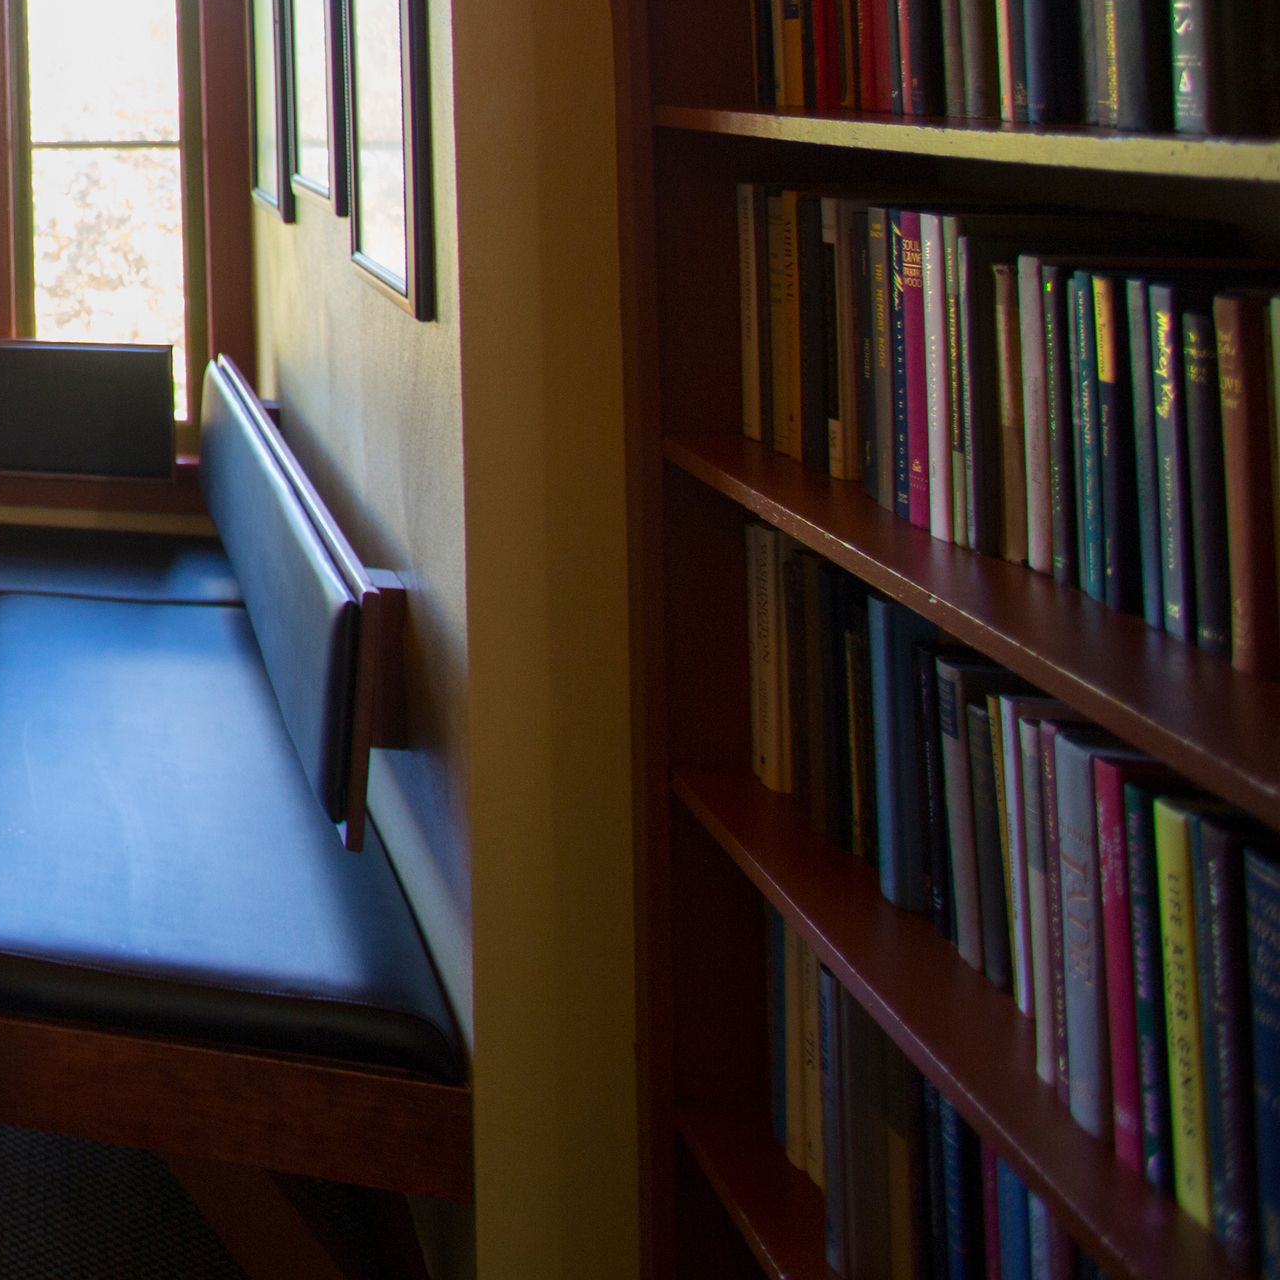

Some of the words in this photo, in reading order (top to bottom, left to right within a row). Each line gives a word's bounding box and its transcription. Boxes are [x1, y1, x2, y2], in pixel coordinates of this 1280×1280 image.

[874, 288, 887, 333] MEMORY
[877, 336, 887, 369] ROOM
[1153, 310, 1174, 378] Monkey
[1154, 382, 1177, 418] King
[758, 542, 772, 666] WASHINGTON
[1167, 872, 1183, 928] LIFE
[1171, 941, 1190, 1021] AFTER
[1177, 1034, 1199, 1140] GENIUS
